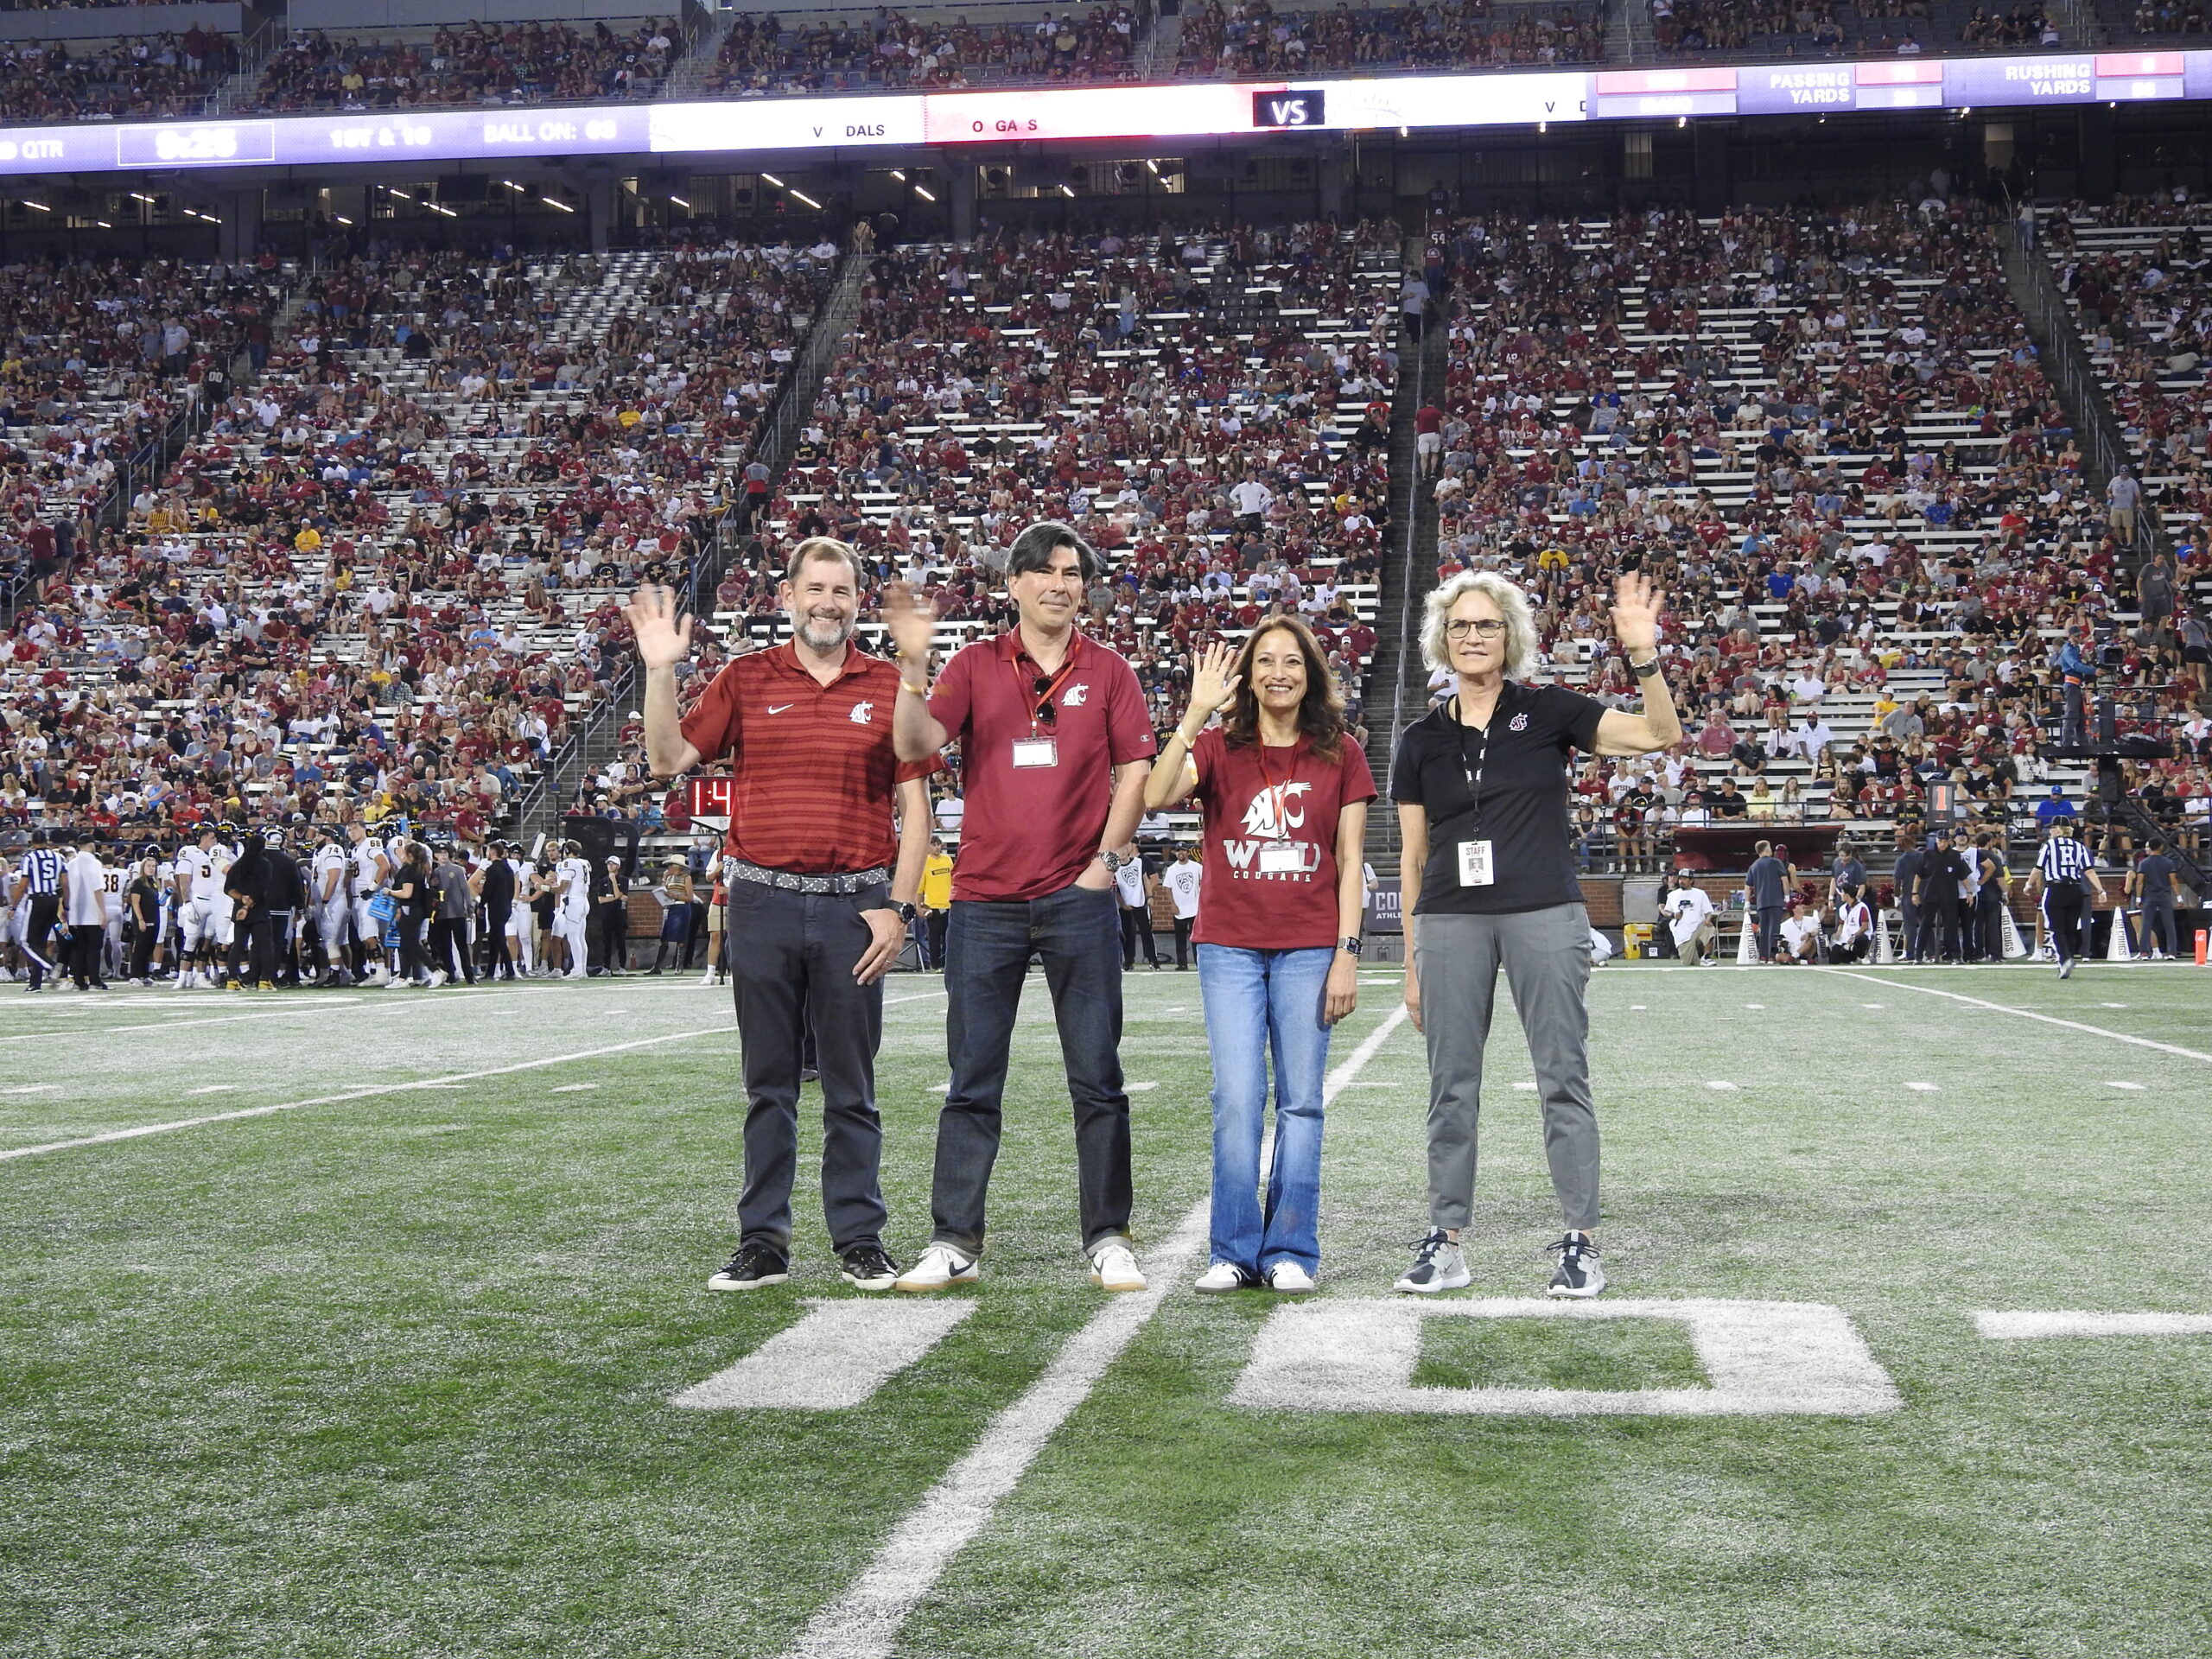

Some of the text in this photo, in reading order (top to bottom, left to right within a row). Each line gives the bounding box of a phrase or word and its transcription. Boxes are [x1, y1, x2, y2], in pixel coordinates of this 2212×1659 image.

[1770, 73, 1850, 88] PASSING
[2005, 64, 2091, 80] RUSHING
[1790, 88, 1850, 104] YARDS
[2031, 79, 2091, 95] YARDS
[1271, 99, 1307, 124] VS
[484, 124, 535, 143] BALL
[539, 122, 577, 141] ON:
[22, 139, 63, 159] QTR
[1937, 785, 1947, 810] 1
[1224, 840, 1321, 872] WU
[1465, 846, 1485, 856] STAFF
[2060, 846, 2075, 864] H
[42, 860, 55, 879] S
[1233, 871, 1312, 882] COUGARS
[1376, 893, 1402, 911] CO
[2001, 915, 2014, 952] GO COUGS
[1747, 935, 1757, 960] COUGS
